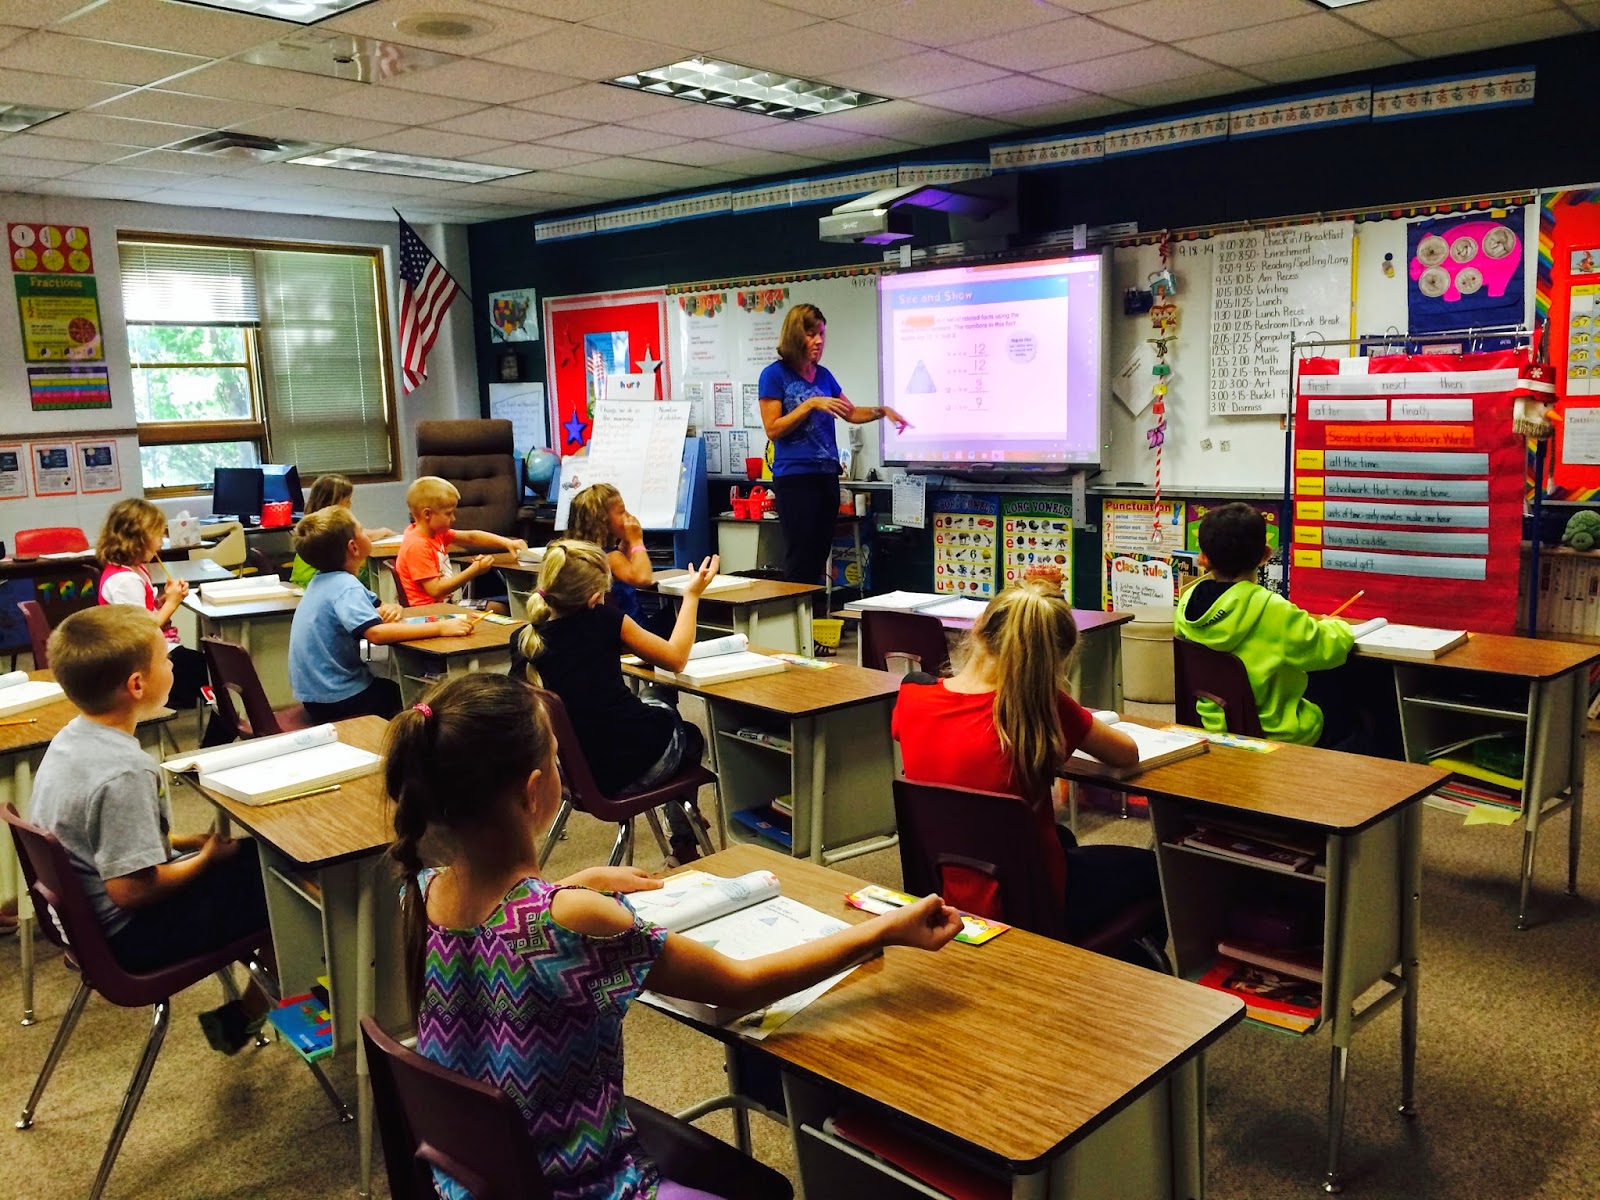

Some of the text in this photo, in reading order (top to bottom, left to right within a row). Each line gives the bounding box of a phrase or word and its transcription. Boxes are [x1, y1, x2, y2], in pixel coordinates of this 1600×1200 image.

[1286, 111, 1297, 121] 85
[1300, 109, 1311, 119] 86
[1314, 107, 1324, 117] 87
[1356, 101, 1367, 111] 90
[1390, 98, 1401, 109] 92
[1406, 97, 1417, 107] 93
[1421, 95, 1432, 106] 94
[1436, 93, 1448, 104] 95
[1451, 91, 1463, 101] 96
[1467, 89, 1479, 99] 97
[1484, 87, 1495, 98] 98
[1500, 85, 1512, 96] 99
[1515, 84, 1531, 94] 100
[1264, 245, 1311, 258] Enrichment
[30, 276, 83, 288] Fractions
[1257, 284, 1289, 295] Writing
[921, 291, 941, 302] and
[944, 290, 973, 301] Show
[1256, 295, 1282, 307] Lunch
[1255, 307, 1280, 318] Lunch
[1320, 316, 1340, 325] Break
[1255, 331, 1290, 343] Computer
[974, 342, 986, 355] 12
[1254, 344, 1279, 354] Music
[974, 359, 986, 371] 12
[1254, 355, 1279, 365] Math
[620, 380, 641, 389] hurt
[975, 378, 982, 391] 3
[1254, 378, 1271, 388] Art
[1307, 377, 1463, 391] first next then
[1250, 389, 1275, 399] Bucket
[975, 397, 983, 408] 9
[1232, 402, 1262, 412] Dismiss
[1315, 403, 1430, 418] after finally
[1328, 430, 1471, 445] Second Grade Vocabulary Words
[1329, 456, 1341, 467] all
[1343, 456, 1357, 468] the
[1328, 482, 1369, 494] schoolwork
[1373, 484, 1389, 495] that
[1402, 485, 1418, 496] done
[1420, 486, 1429, 497] at
[1004, 500, 1072, 517] LONG VOWELS
[1105, 501, 1171, 512] Punctuaton
[1342, 508, 1349, 518] of
[1406, 511, 1422, 522] make
[1437, 511, 1452, 523] hour
[1328, 533, 1387, 547] hug and cuddle
[969, 549, 977, 559] 6
[1028, 552, 1035, 563] 9
[1115, 560, 1140, 574] Class
[1142, 563, 1168, 579] Rules
[1334, 557, 1358, 569] special
[1360, 559, 1375, 571] gift
